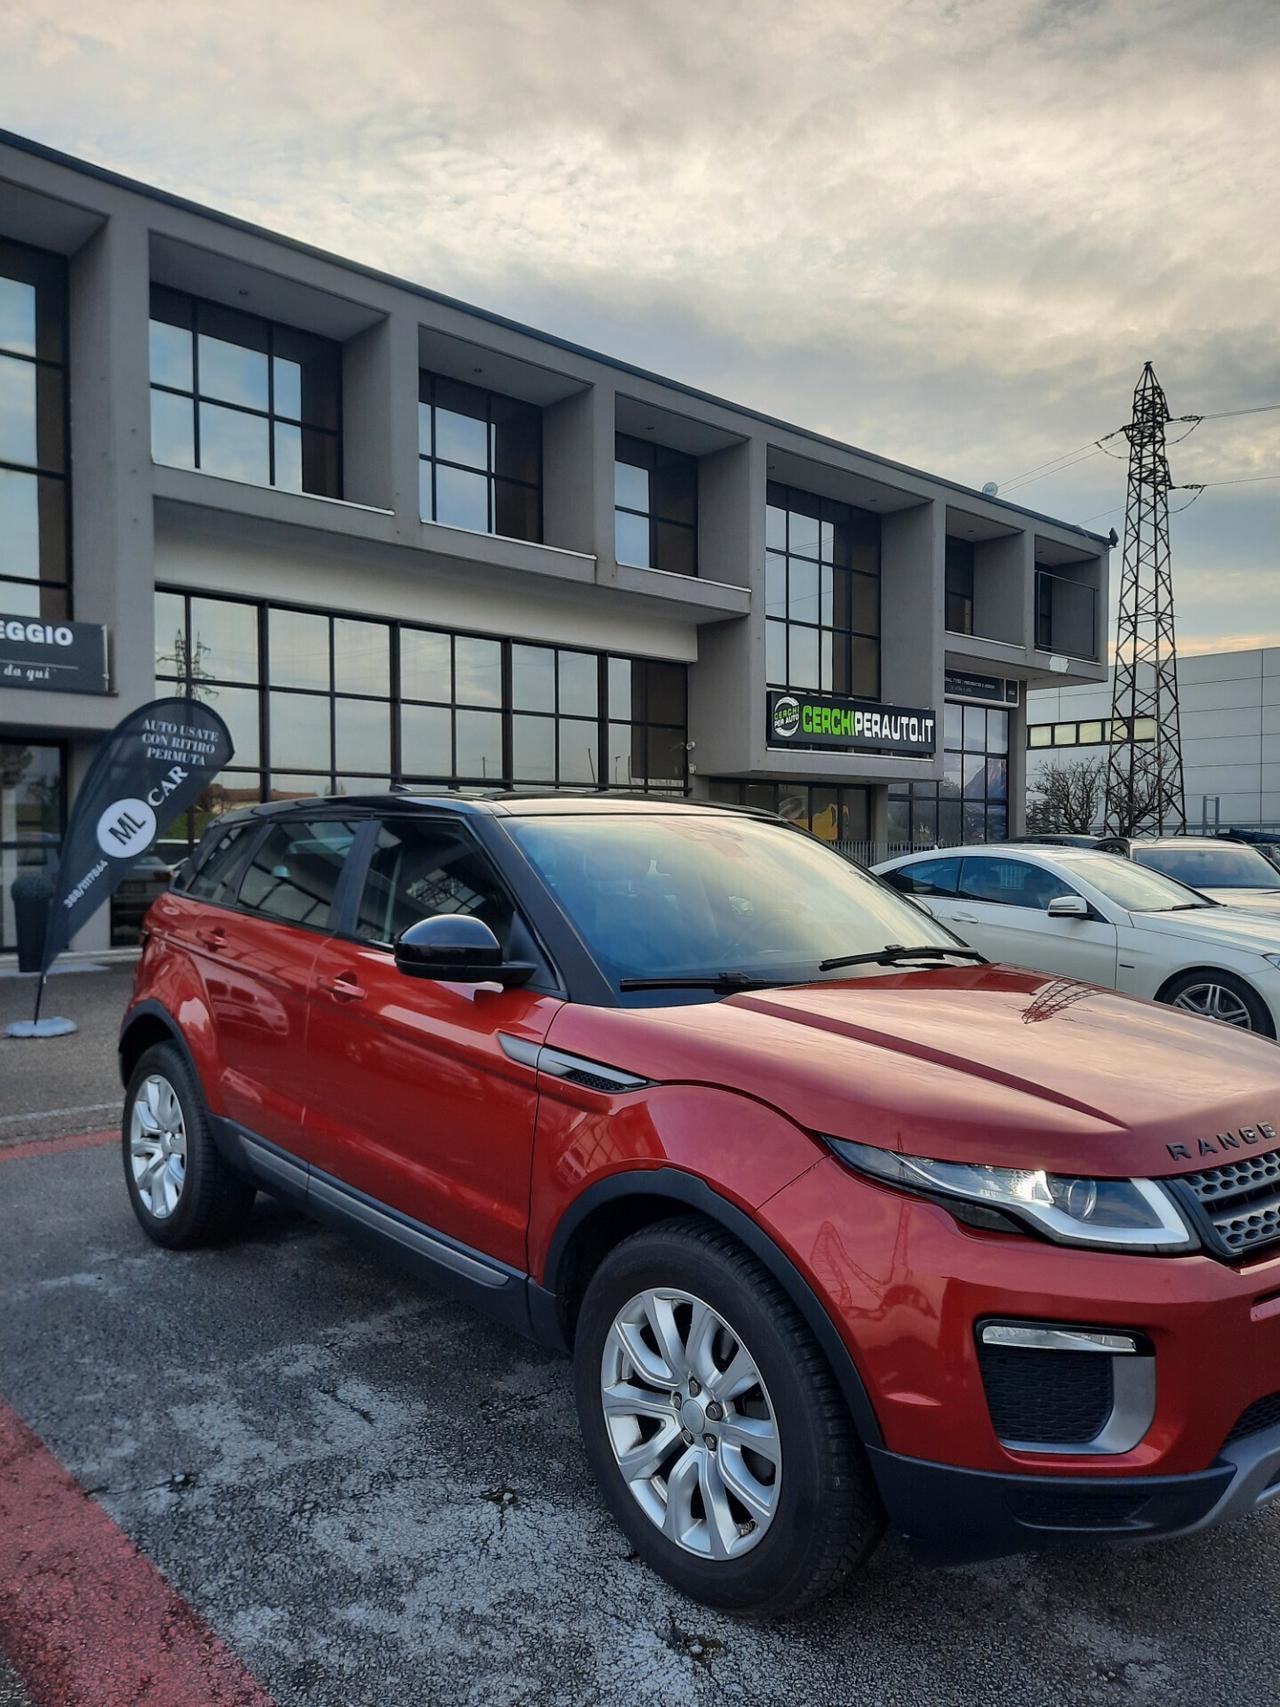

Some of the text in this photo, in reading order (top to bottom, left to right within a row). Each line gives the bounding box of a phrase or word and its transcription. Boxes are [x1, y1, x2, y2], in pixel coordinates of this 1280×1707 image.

[3, 664, 22, 677] da
[774, 706, 799, 721] CERCHI
[785, 713, 799, 724] AUTO
[802, 705, 934, 743] CERCHIPERAUTO.IT
[142, 719, 219, 742] AUTO USATE
[142, 733, 216, 754] CON RITIRO
[146, 746, 206, 766] PERMUTA
[147, 765, 189, 807] CAR
[108, 812, 147, 846] ML
[1166, 1120, 1278, 1161] RANGE
